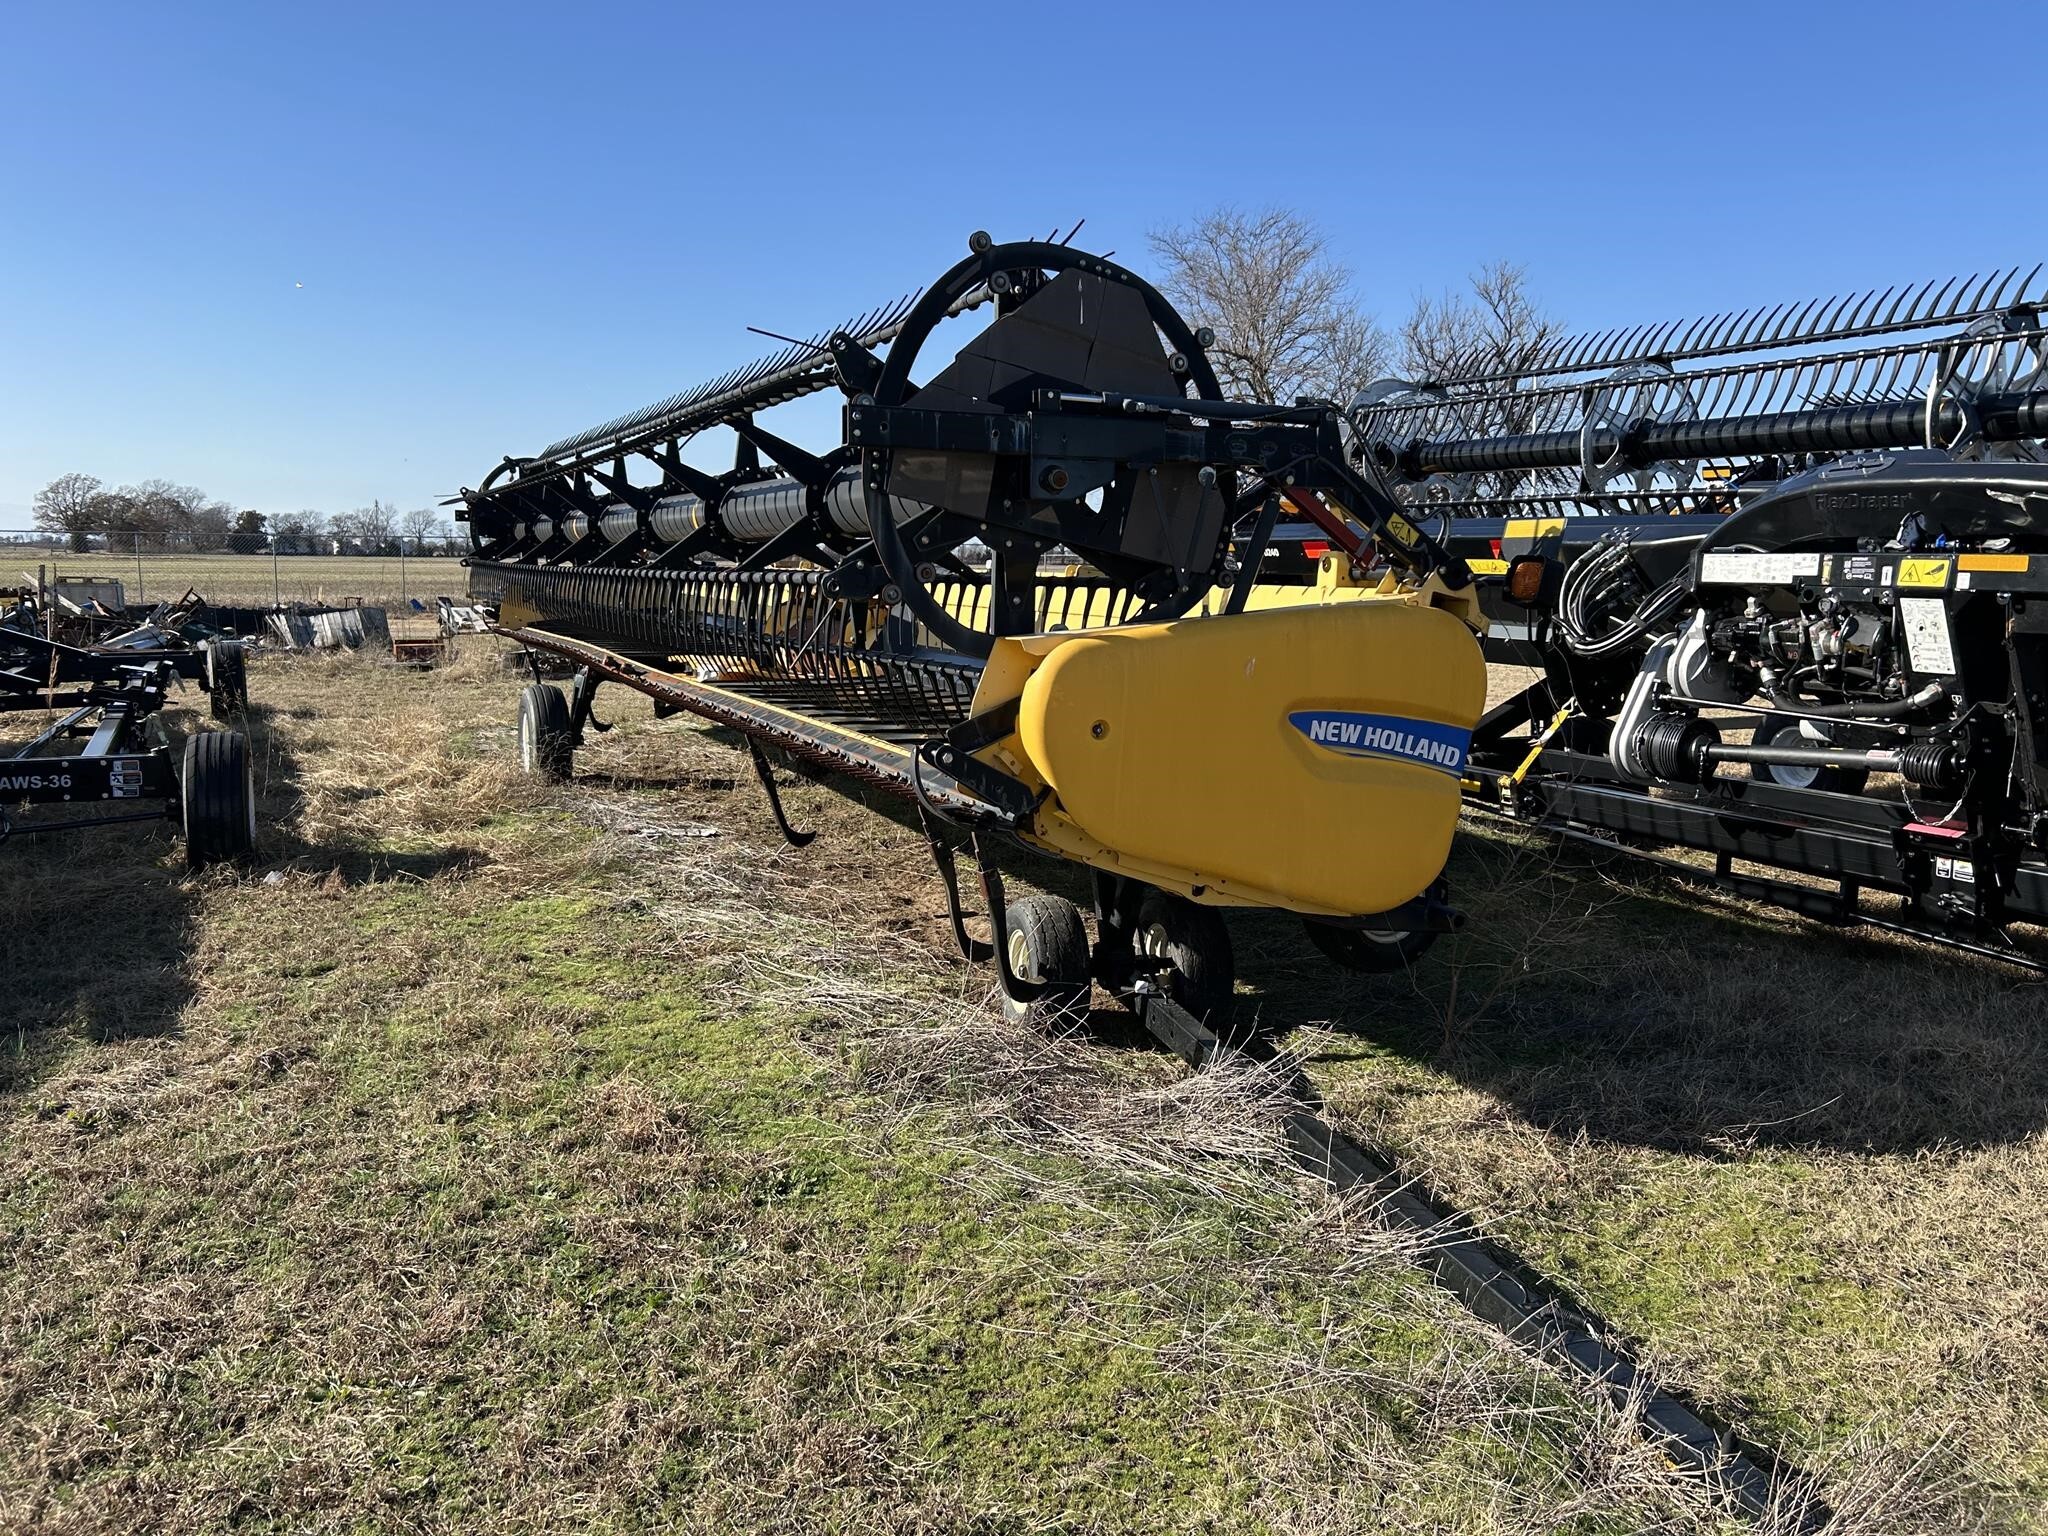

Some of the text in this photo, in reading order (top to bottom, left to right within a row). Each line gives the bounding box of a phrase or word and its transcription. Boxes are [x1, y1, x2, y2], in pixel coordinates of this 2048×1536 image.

[1310, 719, 1461, 768] NEW HOLLAND
[0, 774, 72, 790] AWS-36
